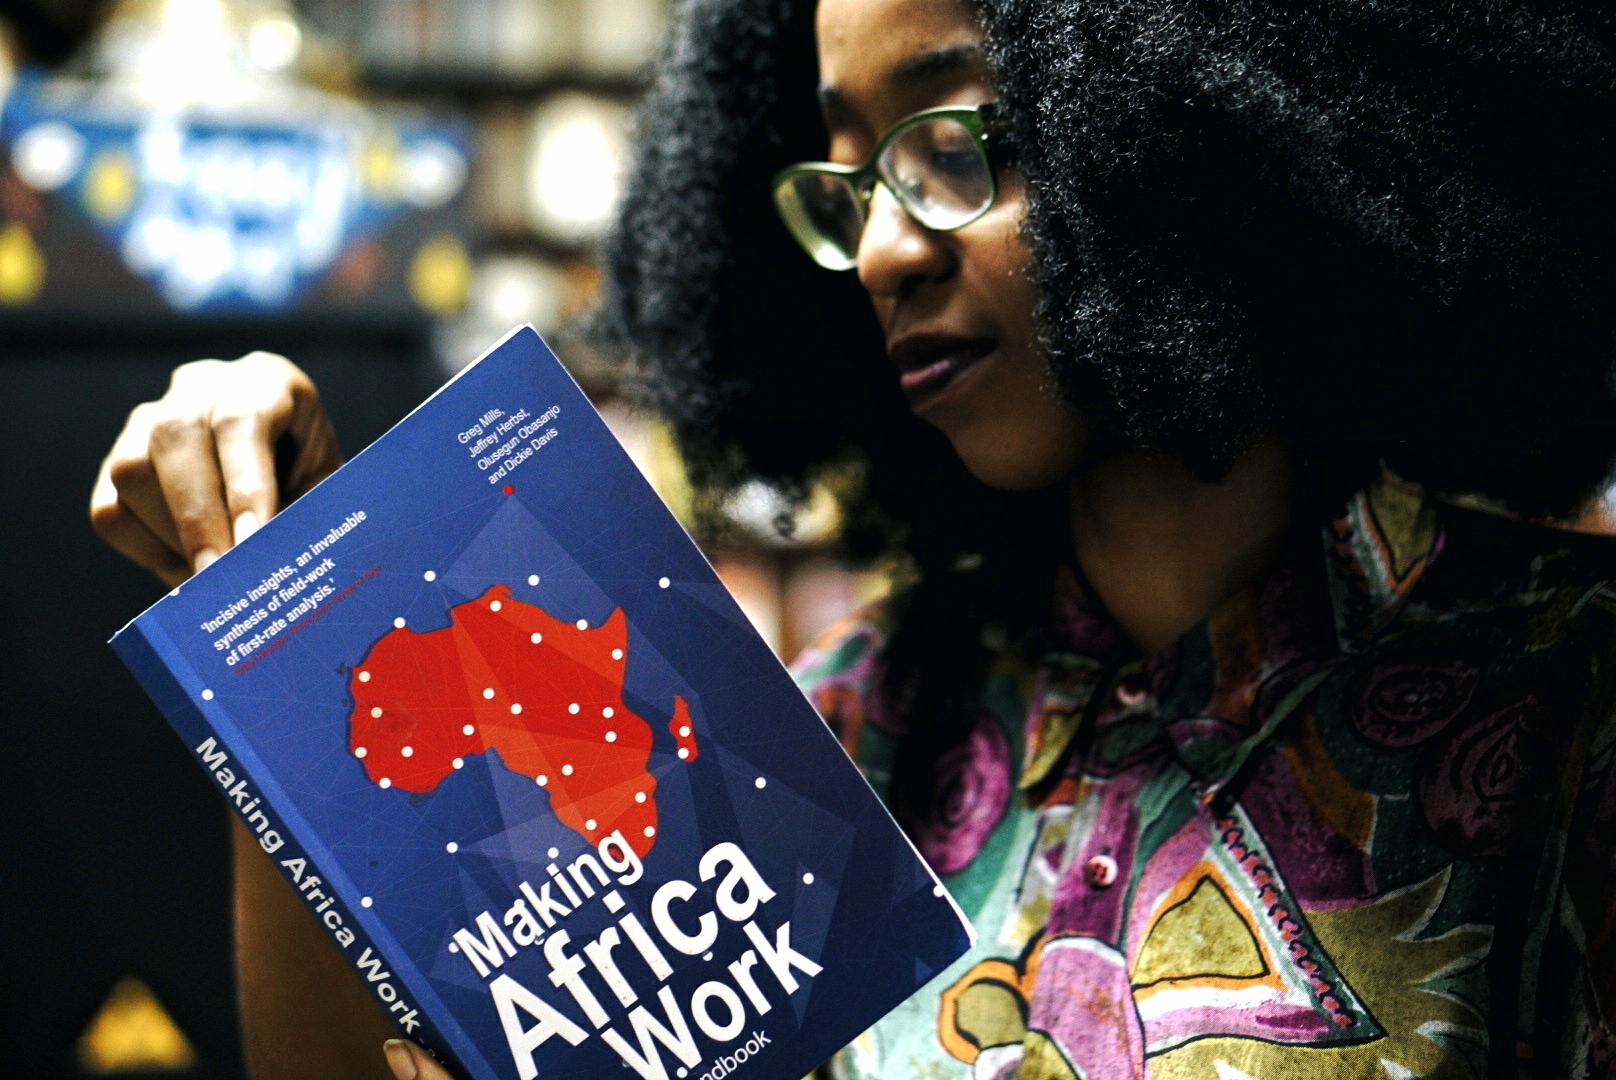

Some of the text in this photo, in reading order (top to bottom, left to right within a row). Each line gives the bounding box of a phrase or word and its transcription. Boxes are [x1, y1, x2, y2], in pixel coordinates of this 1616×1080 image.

[457, 408, 506, 444] Greg Mills,
[468, 408, 531, 458] Jeffrey Herbst,
[477, 405, 561, 471] Olusegun Obasanjo
[488, 427, 559, 485] and Dickie Davis
[246, 564, 299, 602] insights,
[295, 552, 312, 568] an
[310, 509, 367, 556] invaluable
[214, 557, 336, 652] synthesis of field-work
[226, 650, 240, 666] of
[239, 619, 288, 657] first-rate
[195, 736, 422, 1035] Making Africa Work
[453, 829, 644, 978] Making
[489, 841, 777, 1080] Africa
[600, 920, 824, 1080] Work
